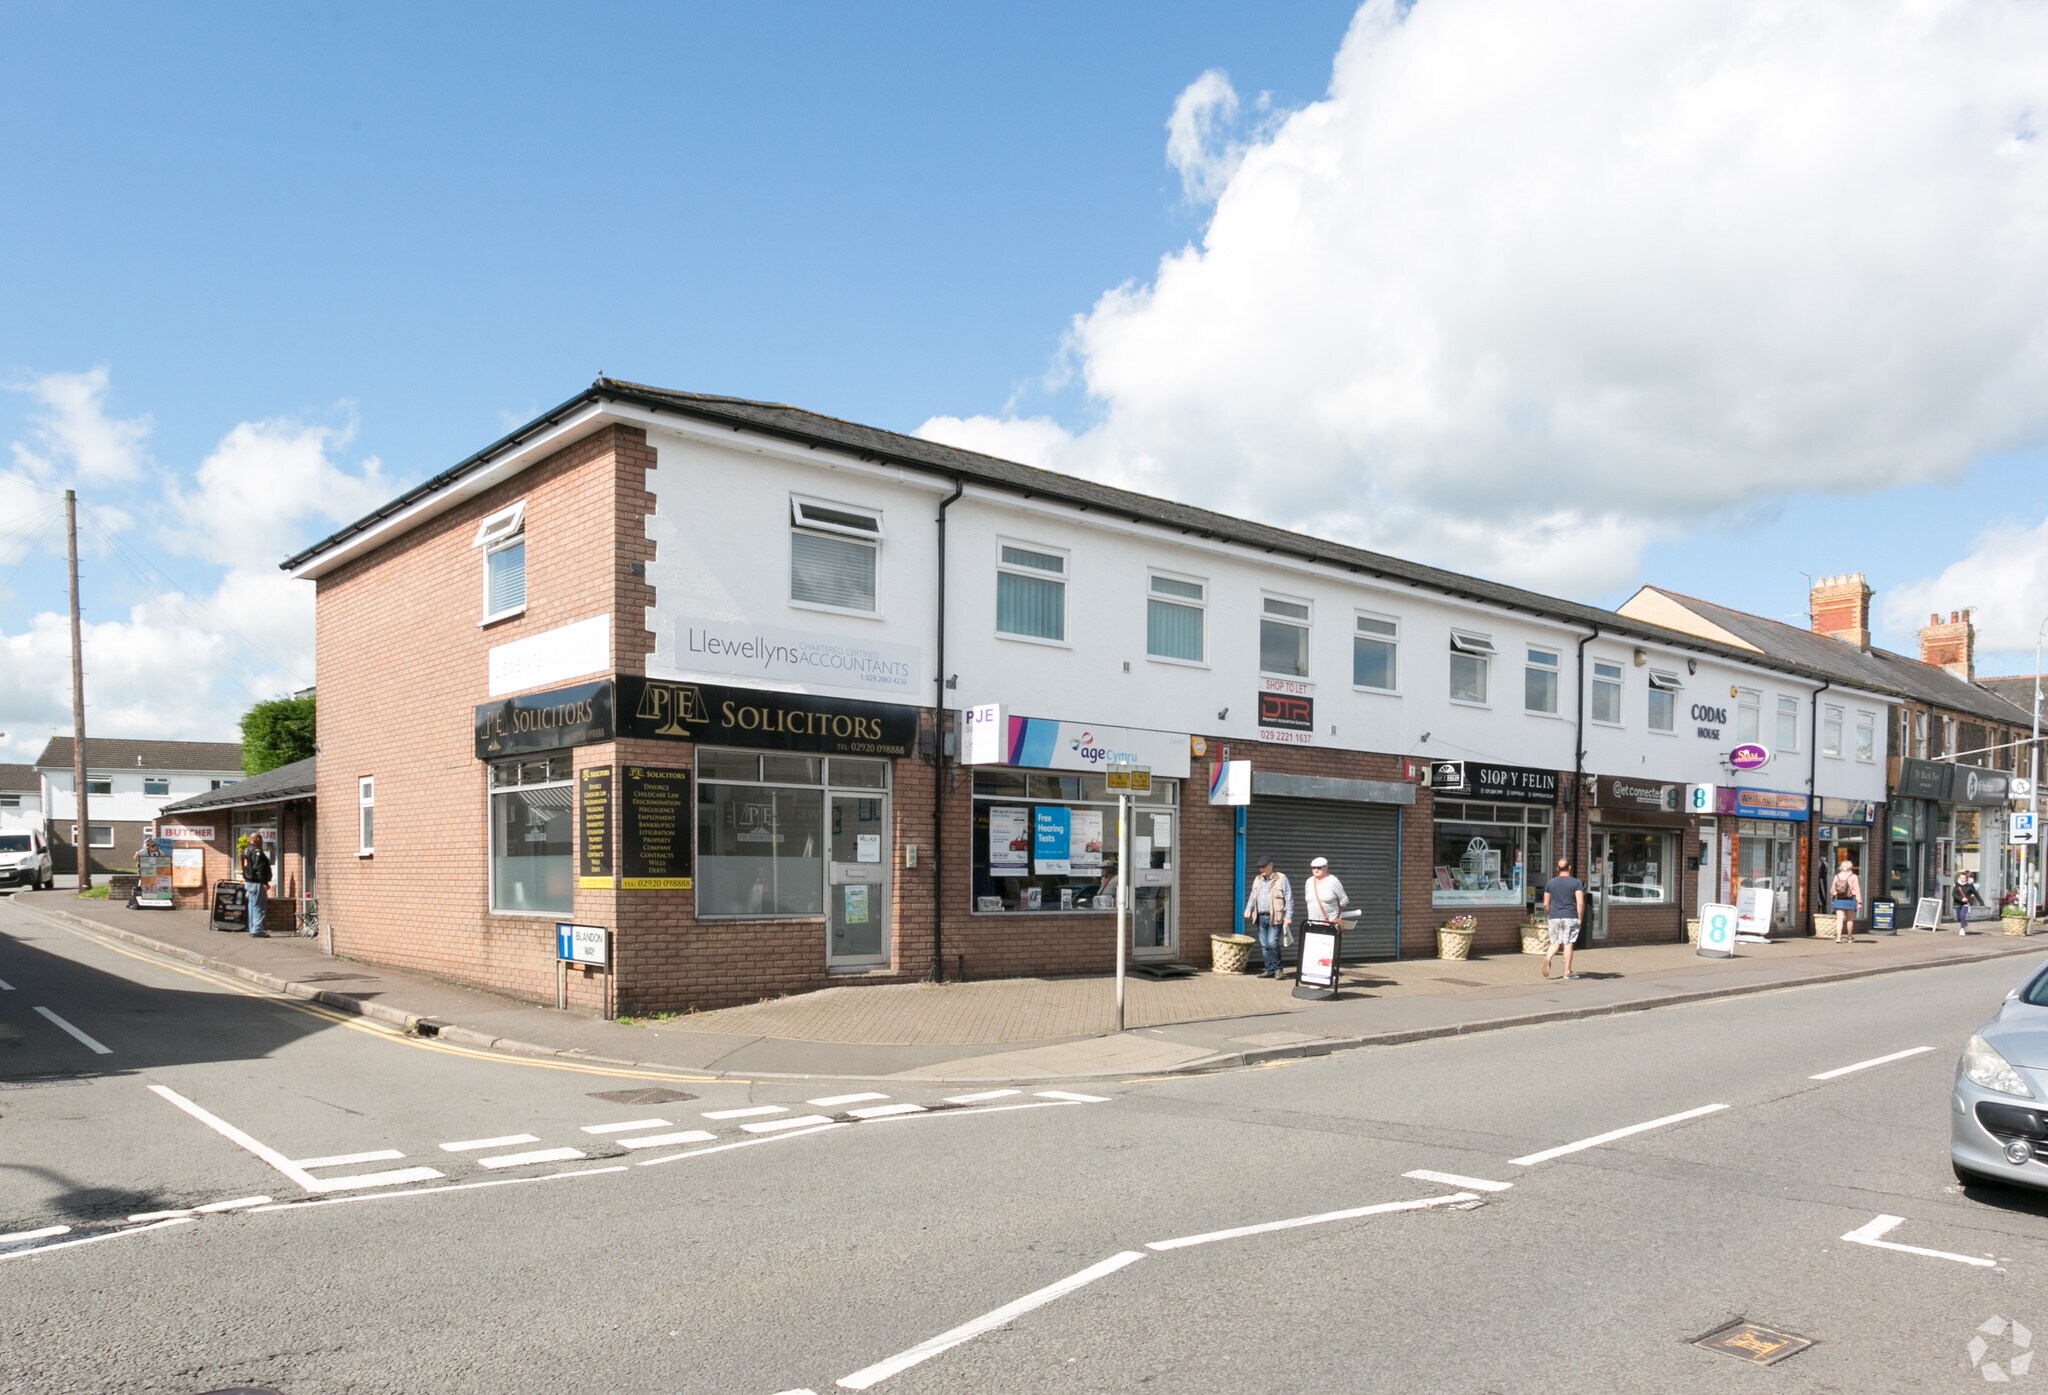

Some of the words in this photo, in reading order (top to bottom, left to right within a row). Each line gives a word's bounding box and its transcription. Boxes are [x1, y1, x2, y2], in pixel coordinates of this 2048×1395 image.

[689, 627, 798, 669] Llewellyns
[799, 642, 843, 655] CHARTERED
[845, 647, 880, 660] CERTIFIED
[799, 651, 909, 677] ACCOUNTANTS
[1265, 679, 1284, 691] SHOP
[1286, 682, 1294, 693] TO
[1295, 684, 1307, 694] LET
[512, 698, 593, 734] SOLICITORS
[721, 700, 882, 740] SOLICITORS
[966, 708, 994, 725] PJE
[1691, 703, 1727, 725] CODAS
[1260, 729, 1274, 740] 029
[1276, 731, 1293, 742] 2221
[1295, 733, 1311, 743] 1637
[1697, 726, 1720, 740] HOUSE
[850, 742, 875, 753] 02920
[876, 744, 905, 755] 098888
[1081, 747, 1106, 764] age
[1106, 749, 1138, 763] Cymru
[646, 770, 686, 779] SOLICITORS
[1480, 768, 1507, 785] SIOP
[1511, 772, 1518, 786] Y
[1522, 773, 1555, 789] FELIN
[1629, 786, 1664, 799] connected
[638, 813, 676, 821] EMPLOYMENT
[1037, 813, 1053, 822] Free
[165, 828, 212, 837] BUTCHER
[1037, 823, 1064, 835] Hearing
[1037, 833, 1055, 842] Tests
[637, 879, 662, 888] 02920
[663, 879, 691, 888] 098888
